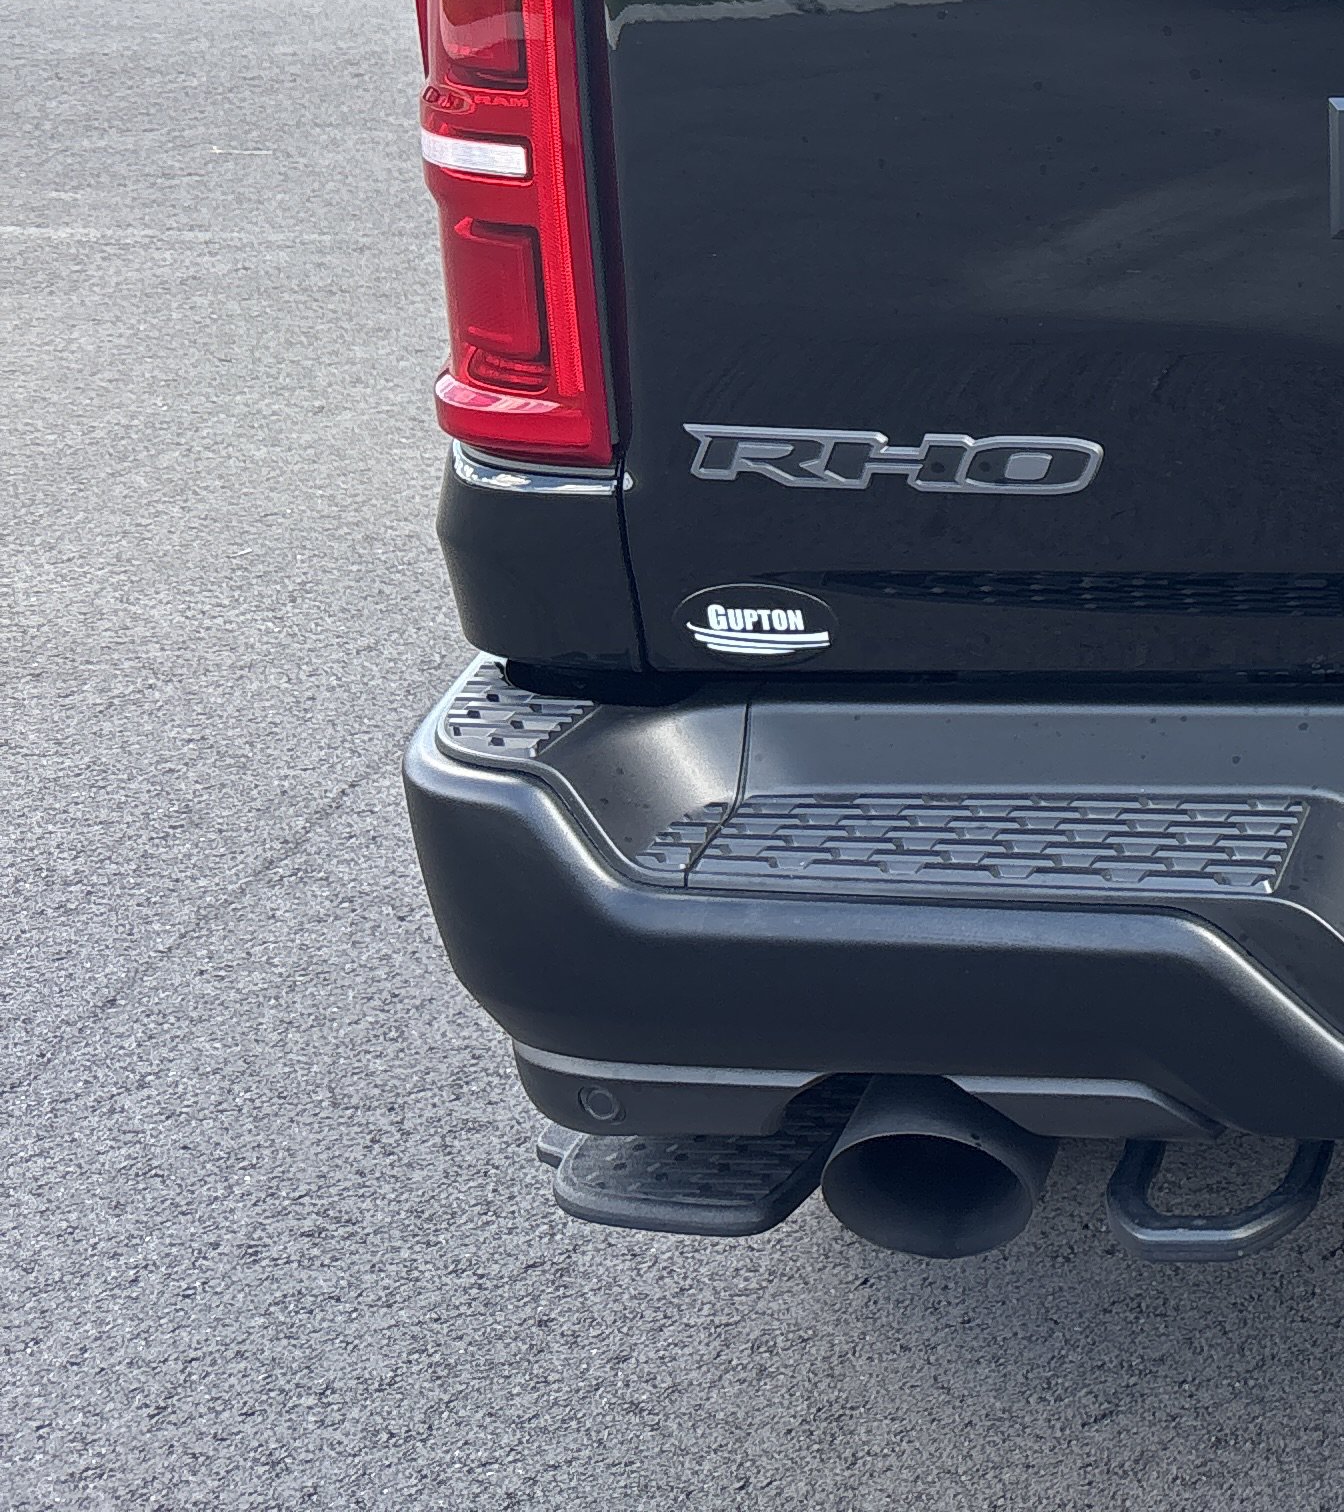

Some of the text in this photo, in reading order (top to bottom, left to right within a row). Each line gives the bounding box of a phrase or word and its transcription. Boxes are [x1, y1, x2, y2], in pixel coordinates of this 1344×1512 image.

[474, 94, 530, 108] RAM
[683, 423, 1105, 496] RHO
[707, 603, 805, 631] GUPTON
